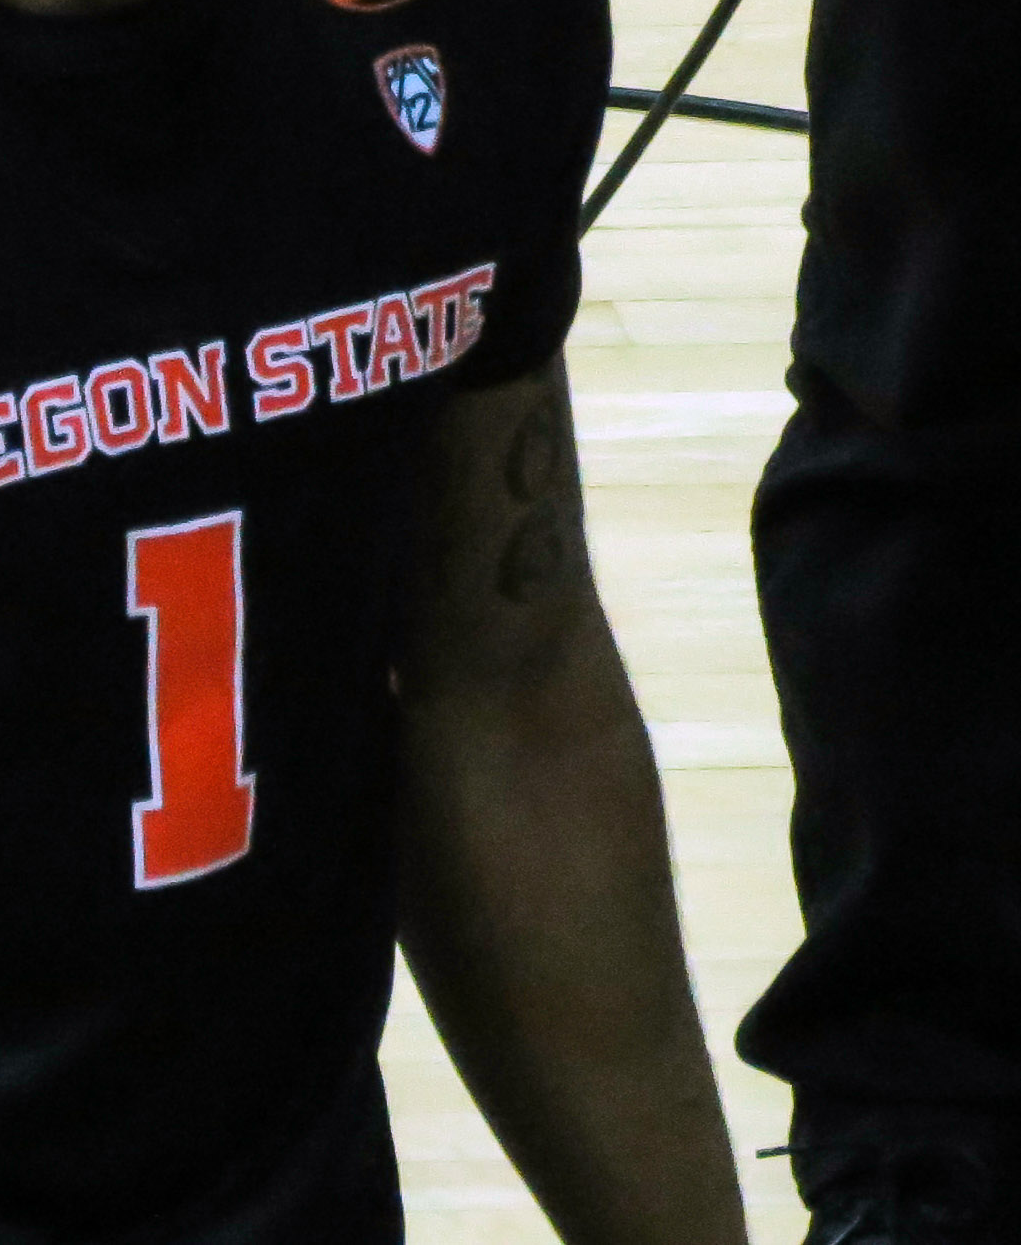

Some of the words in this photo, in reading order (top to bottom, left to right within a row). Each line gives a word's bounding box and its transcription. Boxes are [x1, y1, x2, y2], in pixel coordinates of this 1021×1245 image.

[403, 92, 438, 132] 12
[246, 261, 496, 423] STATE
[127, 510, 255, 890] 1
